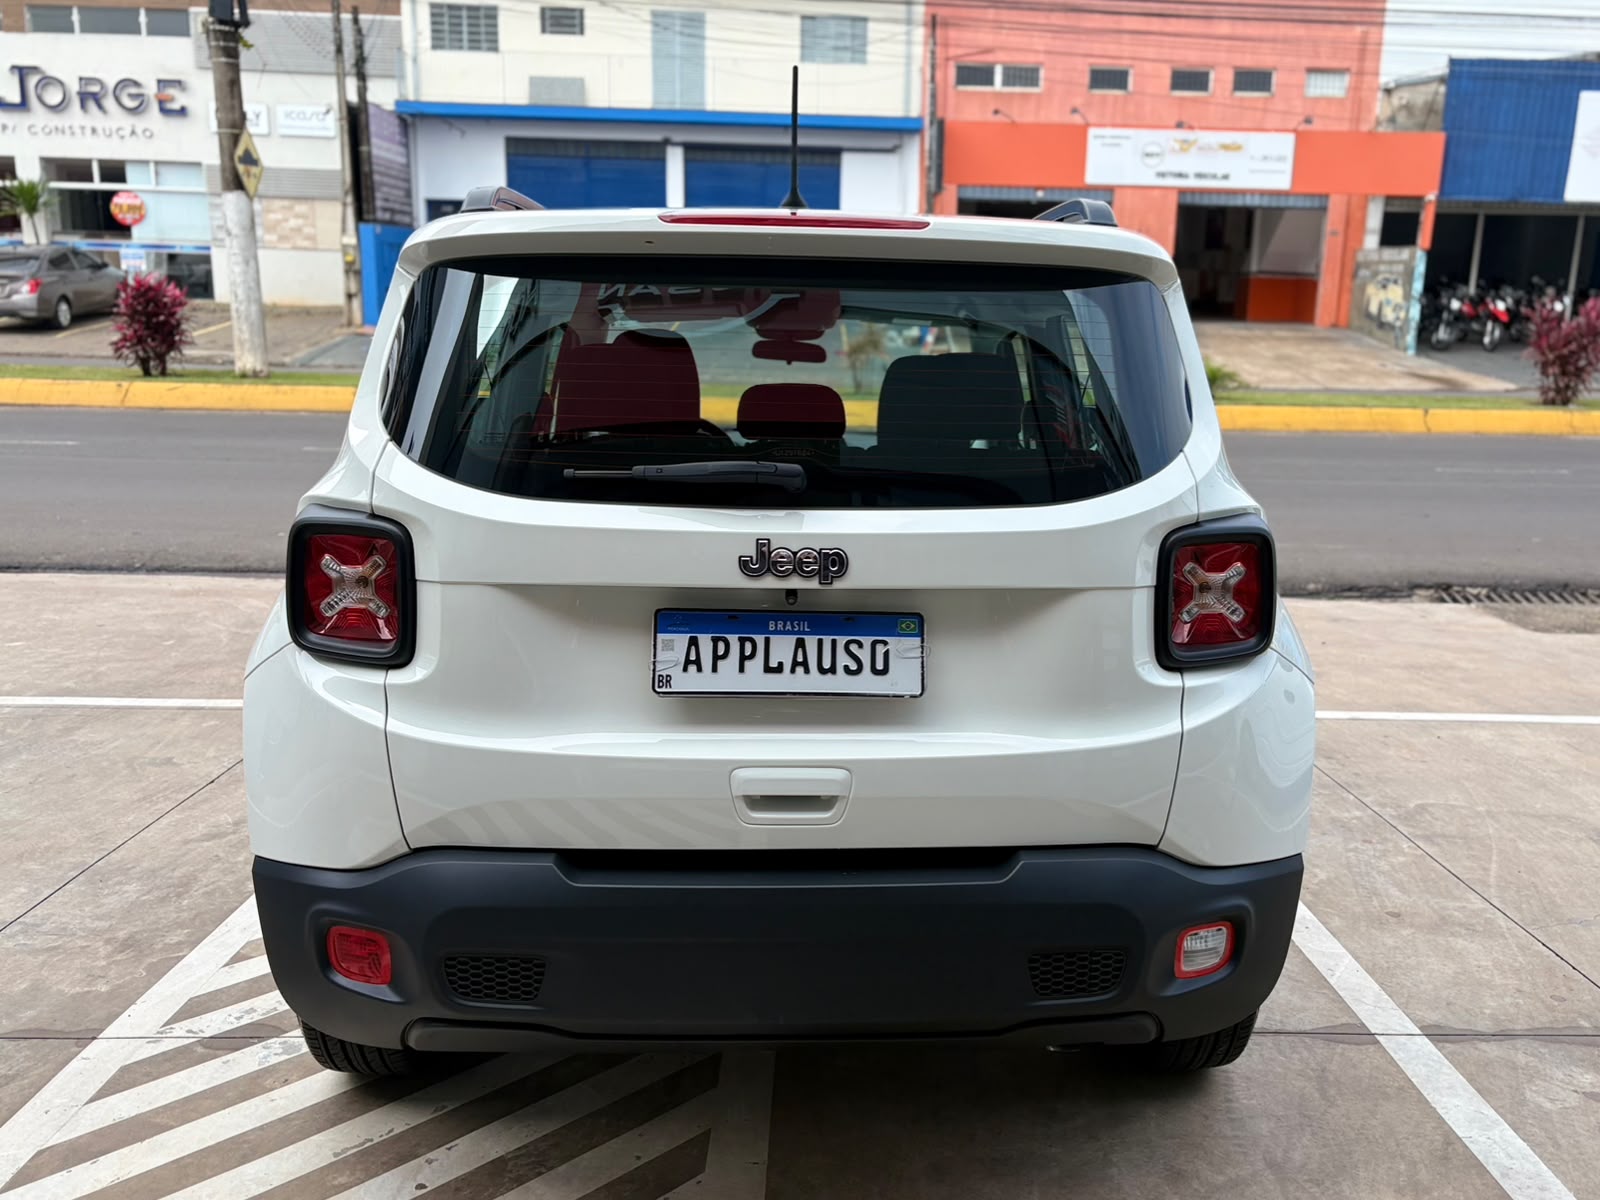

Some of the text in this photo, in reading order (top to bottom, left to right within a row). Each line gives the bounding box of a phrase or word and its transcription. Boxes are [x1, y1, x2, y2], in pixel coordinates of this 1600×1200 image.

[0, 64, 188, 117] JORGE
[27, 124, 155, 140] CONSTRUÇÃO
[738, 538, 848, 584] Jeep
[768, 620, 811, 632] BRASIL
[682, 635, 890, 676] APPLAUSO
[657, 674, 673, 689] BR
